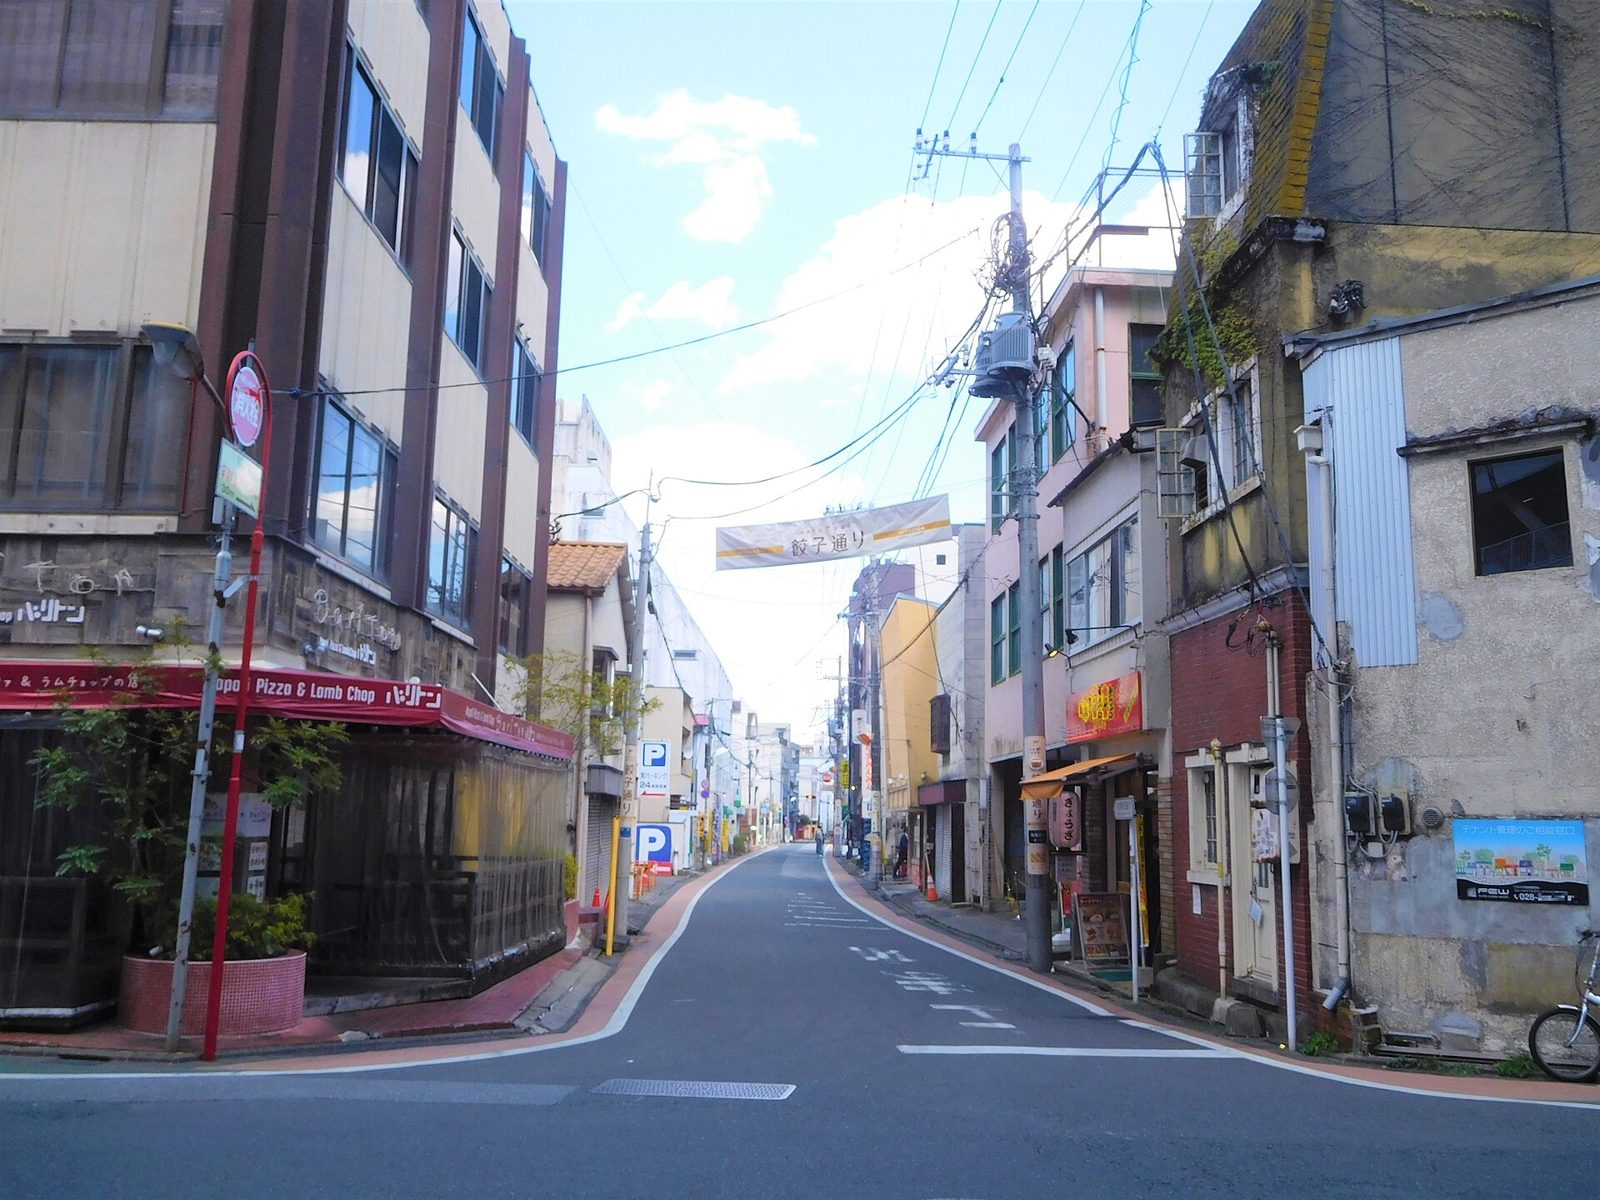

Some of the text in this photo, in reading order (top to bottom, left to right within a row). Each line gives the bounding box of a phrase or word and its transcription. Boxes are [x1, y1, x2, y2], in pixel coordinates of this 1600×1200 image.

[791, 530, 865, 558] 餃子通り
[17, 599, 85, 622] バリトン
[20, 675, 31, 687] &
[256, 678, 292, 697] Pizza
[297, 681, 306, 697] &
[310, 684, 343, 700] Lamb
[347, 685, 375, 705] Chop
[385, 684, 442, 708] バリトン
[643, 744, 665, 767] P
[1064, 797, 1074, 841] ぎょうざ
[638, 827, 666, 863] P
